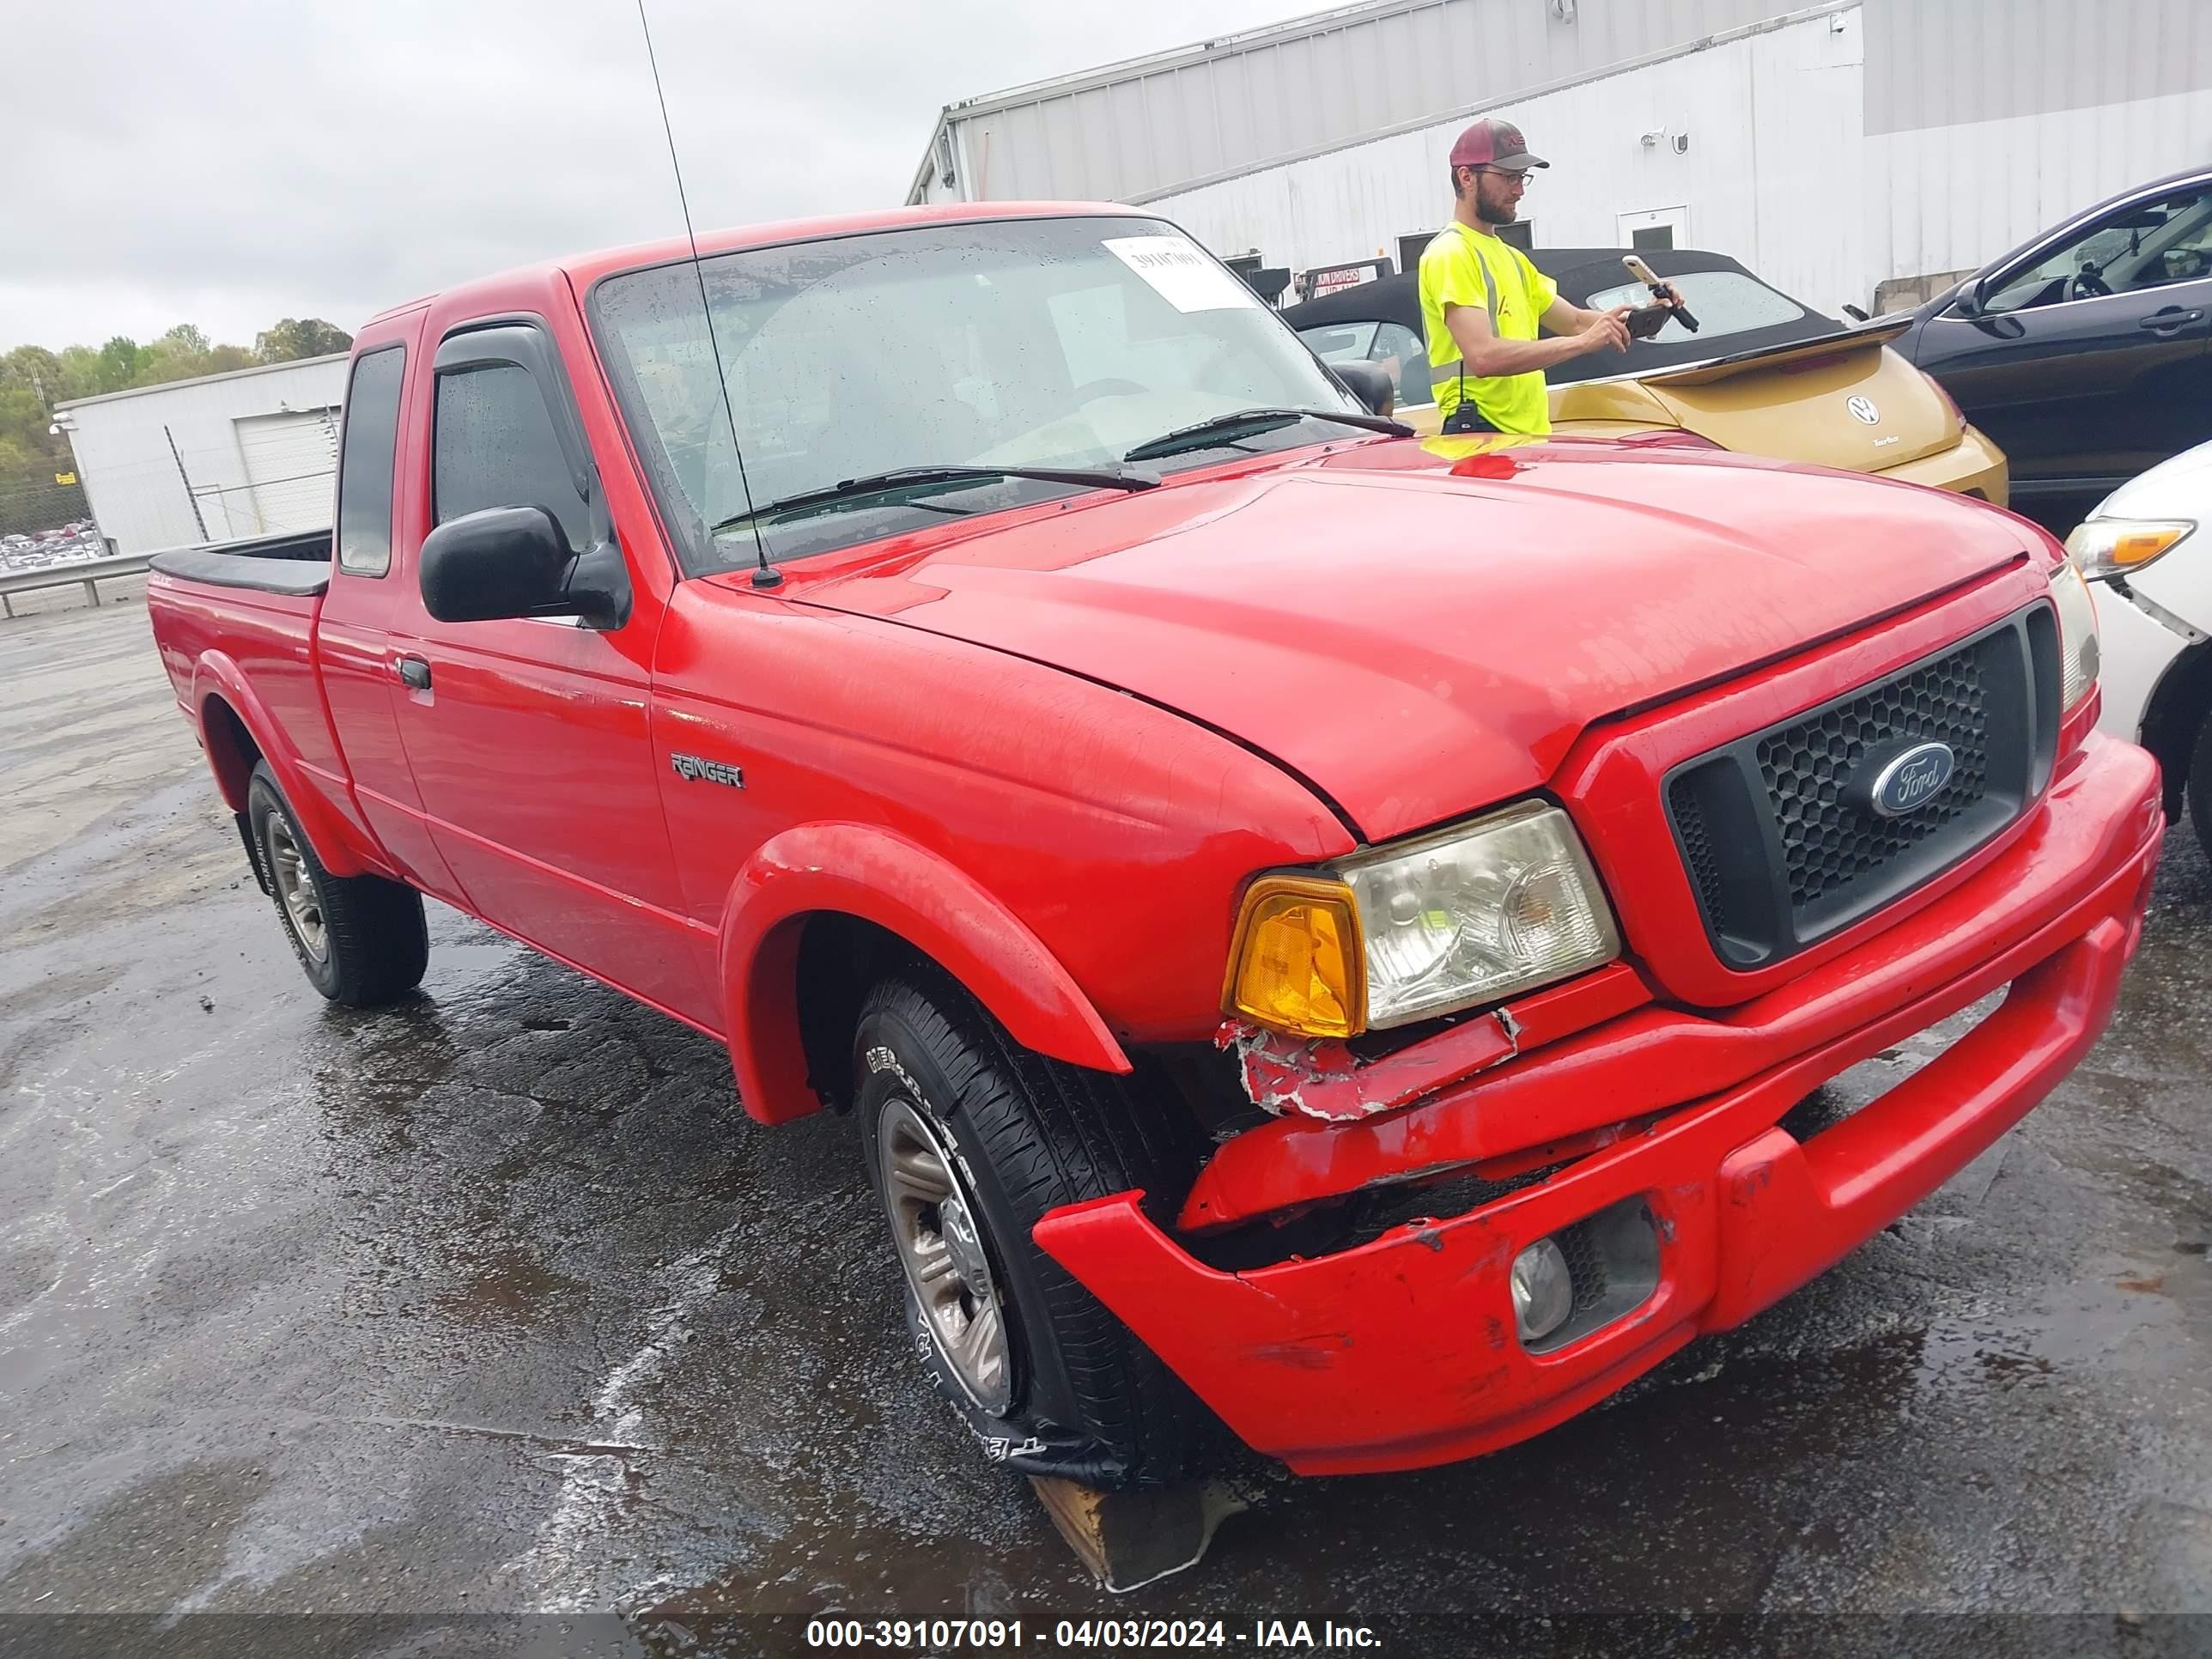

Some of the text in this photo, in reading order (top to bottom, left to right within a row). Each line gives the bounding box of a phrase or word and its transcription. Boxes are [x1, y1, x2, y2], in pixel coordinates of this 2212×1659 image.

[1331, 267, 1359, 283] DRIVERS
[671, 753, 742, 788] RANGER
[1898, 757, 1940, 802] Ford
